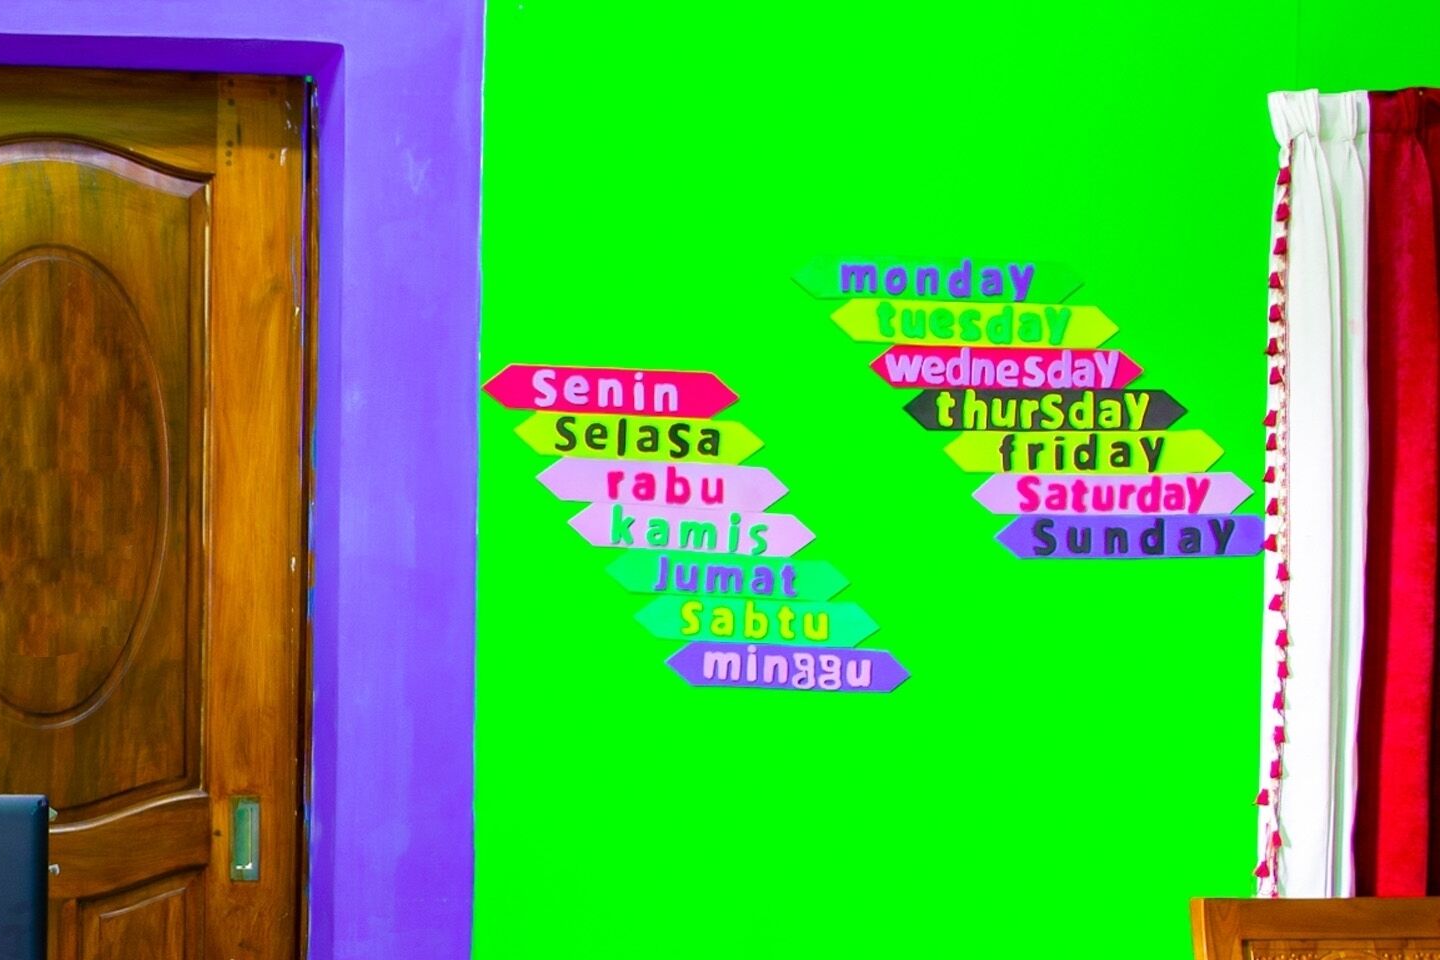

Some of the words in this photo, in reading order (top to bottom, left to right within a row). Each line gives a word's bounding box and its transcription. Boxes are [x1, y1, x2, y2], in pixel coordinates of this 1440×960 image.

[841, 259, 1034, 302] monday
[876, 301, 1072, 345] tuesday
[885, 347, 1119, 389] wednesday
[531, 369, 678, 412] Senin
[999, 434, 1165, 473] friday
[606, 466, 724, 505] rabu
[1017, 475, 1210, 515] Saturday
[610, 504, 769, 556] kamis
[1032, 518, 1235, 556] Sunday
[679, 600, 830, 641] Sabtu
[702, 645, 872, 690] minggu
